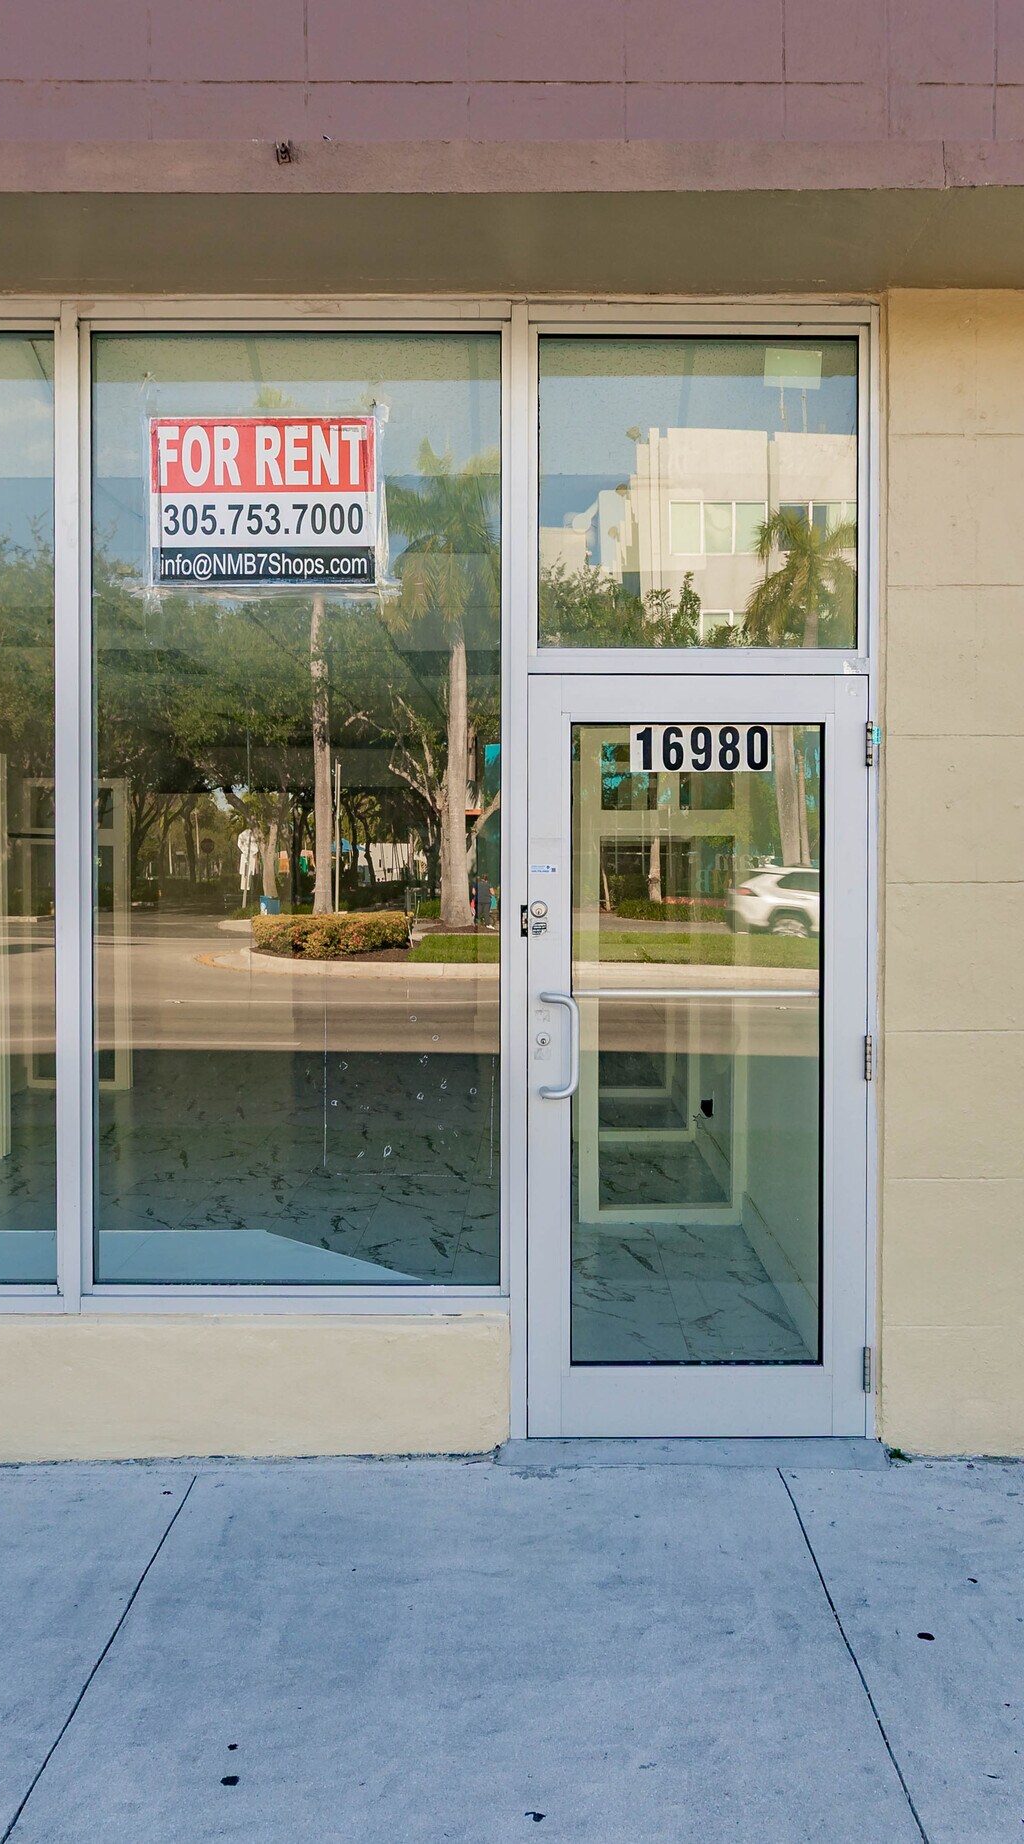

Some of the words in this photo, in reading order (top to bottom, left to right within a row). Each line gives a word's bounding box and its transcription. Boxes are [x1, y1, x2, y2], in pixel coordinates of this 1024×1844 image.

[157, 424, 242, 487] FOR
[255, 424, 368, 486] RENT
[163, 502, 364, 536] 305.753.7000
[160, 552, 368, 581] info@NMB7Shops.com
[636, 725, 769, 771] 16980
